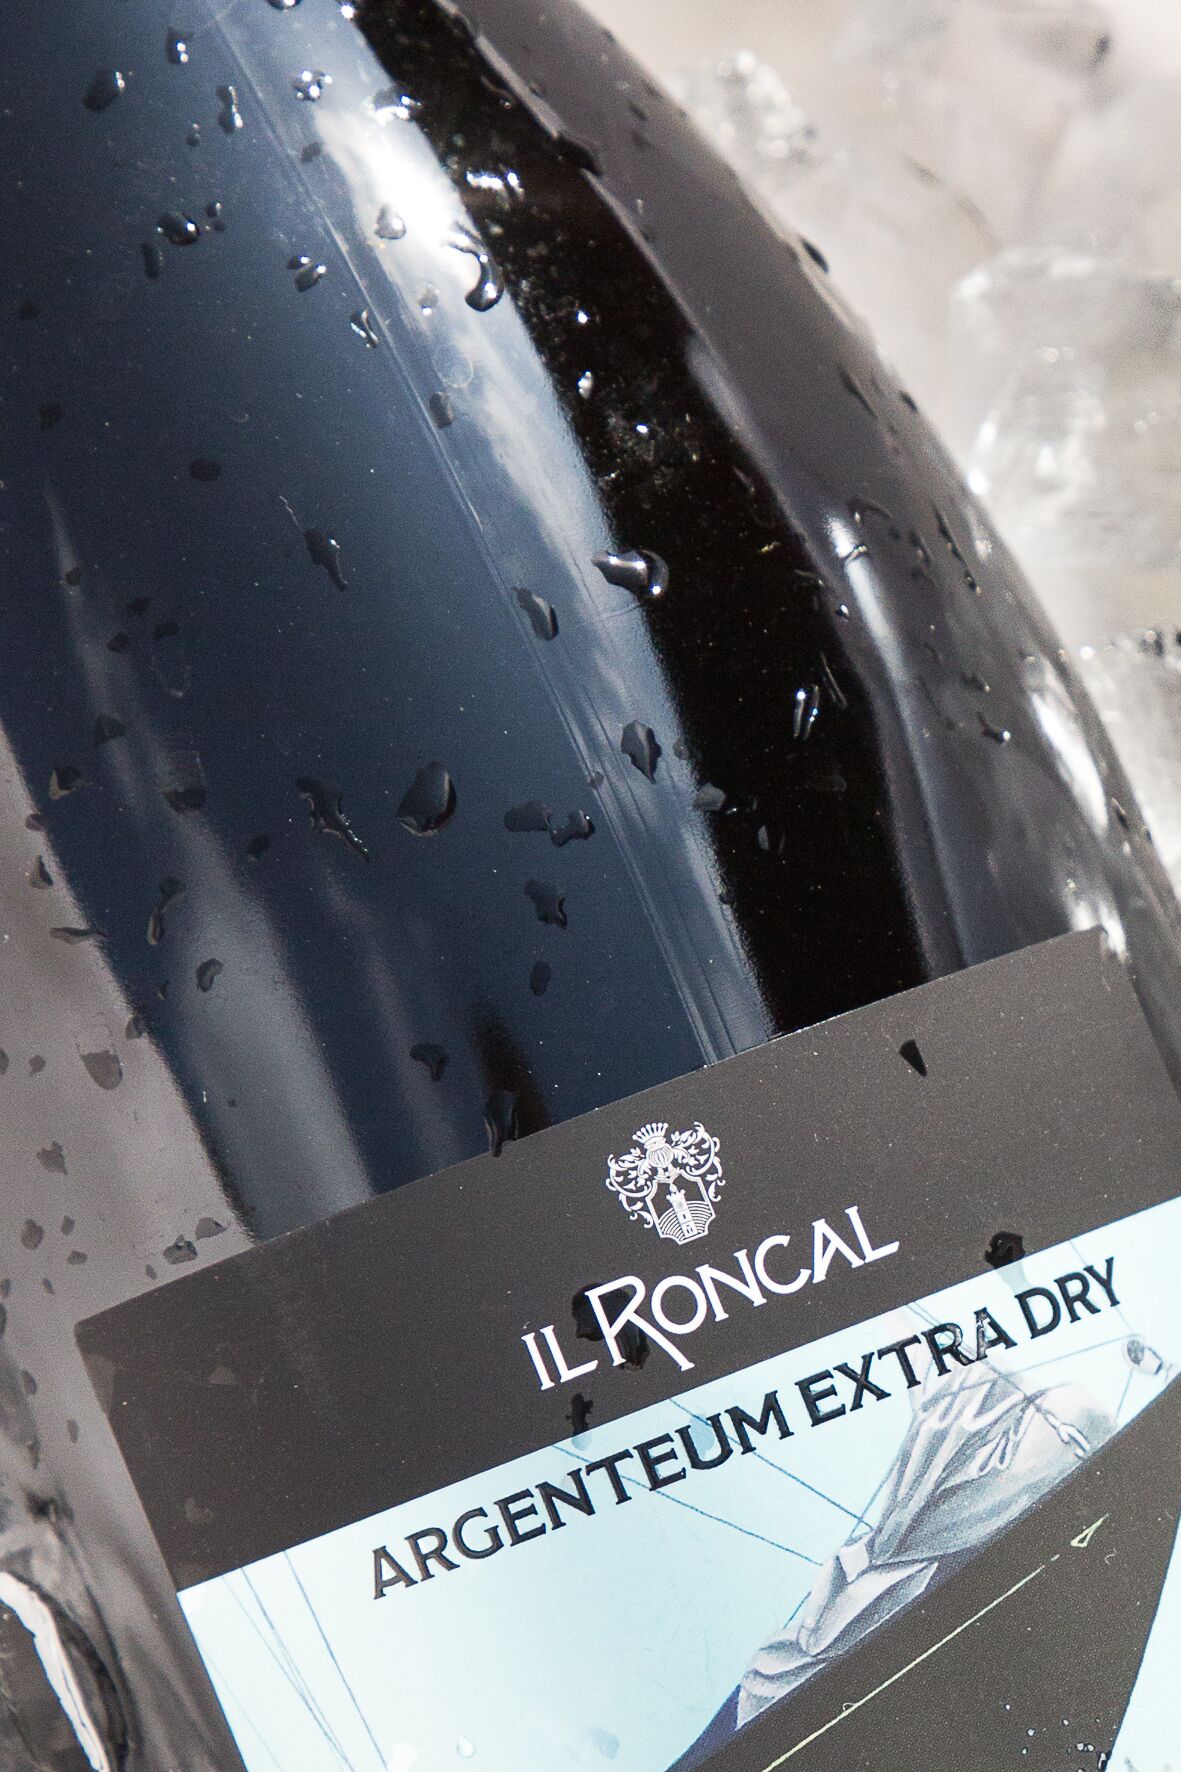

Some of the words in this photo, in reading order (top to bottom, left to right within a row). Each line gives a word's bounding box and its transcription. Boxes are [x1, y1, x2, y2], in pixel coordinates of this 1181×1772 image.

[372, 1389, 795, 1600] ARGENTEUM
[794, 1306, 1018, 1428] EXTRA
[1014, 1256, 1121, 1340] DRY
[521, 1330, 600, 1390] IL
[584, 1205, 900, 1371] RONCAL
